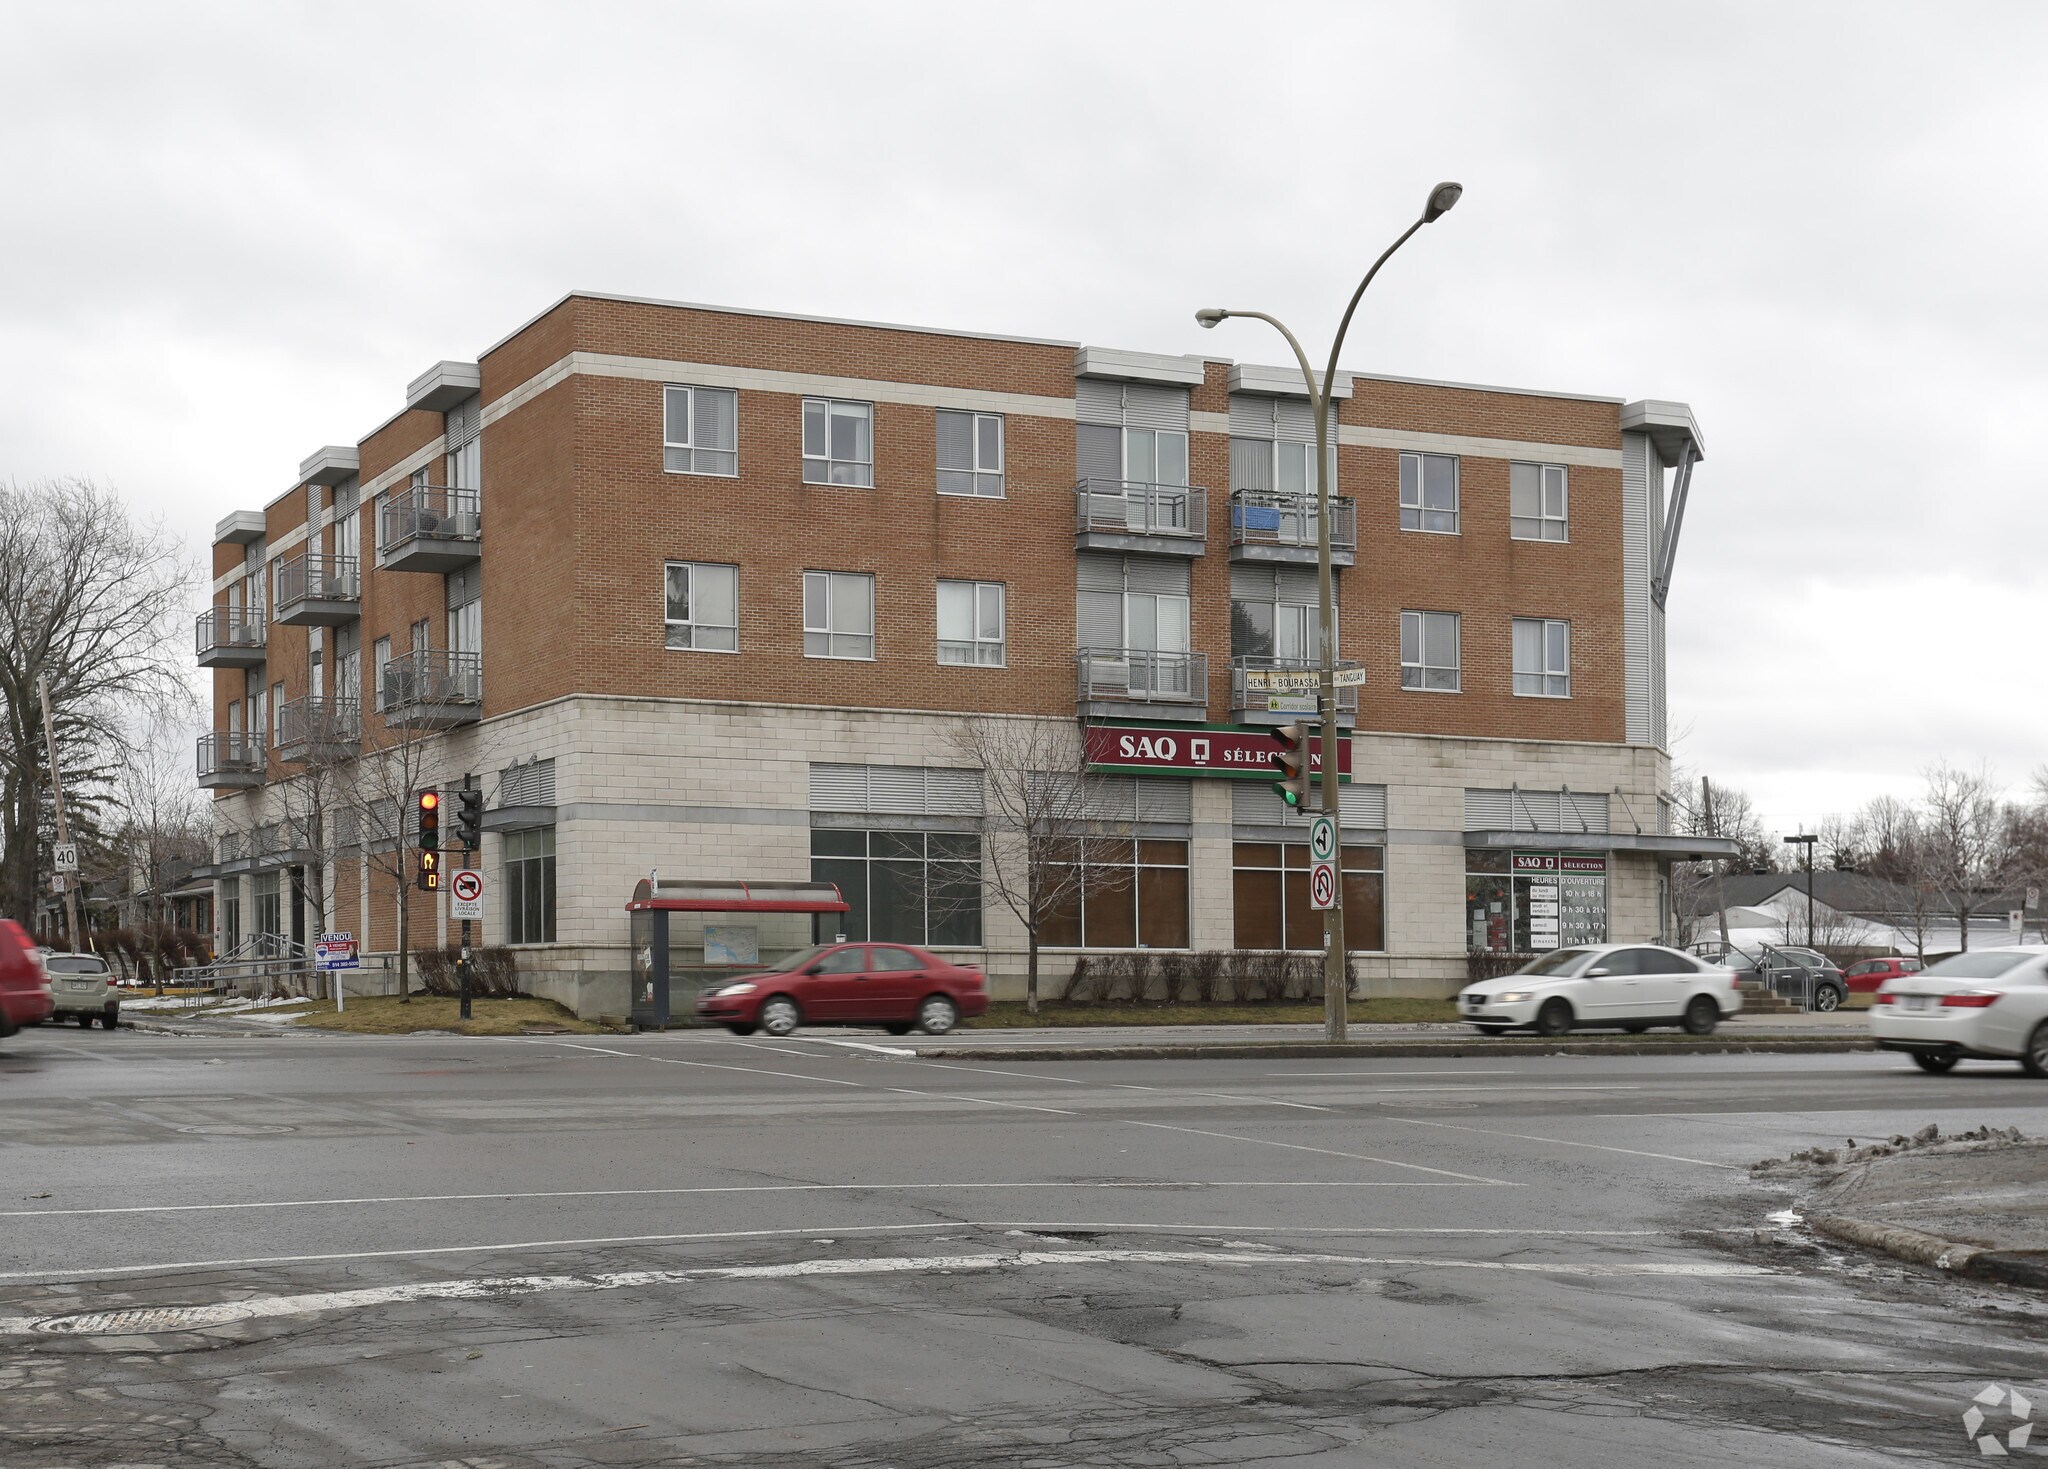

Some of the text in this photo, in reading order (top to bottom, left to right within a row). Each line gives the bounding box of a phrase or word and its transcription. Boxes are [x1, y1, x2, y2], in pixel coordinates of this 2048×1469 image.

[1280, 701, 1317, 711] Corridor scolaire
[1118, 735, 1177, 761] SAQ
[57, 850, 75, 864] 40
[1518, 857, 1541, 868] SAQ
[1593, 922, 1600, 930] 17
[1601, 922, 1606, 930] h
[323, 934, 350, 942] VENDU
